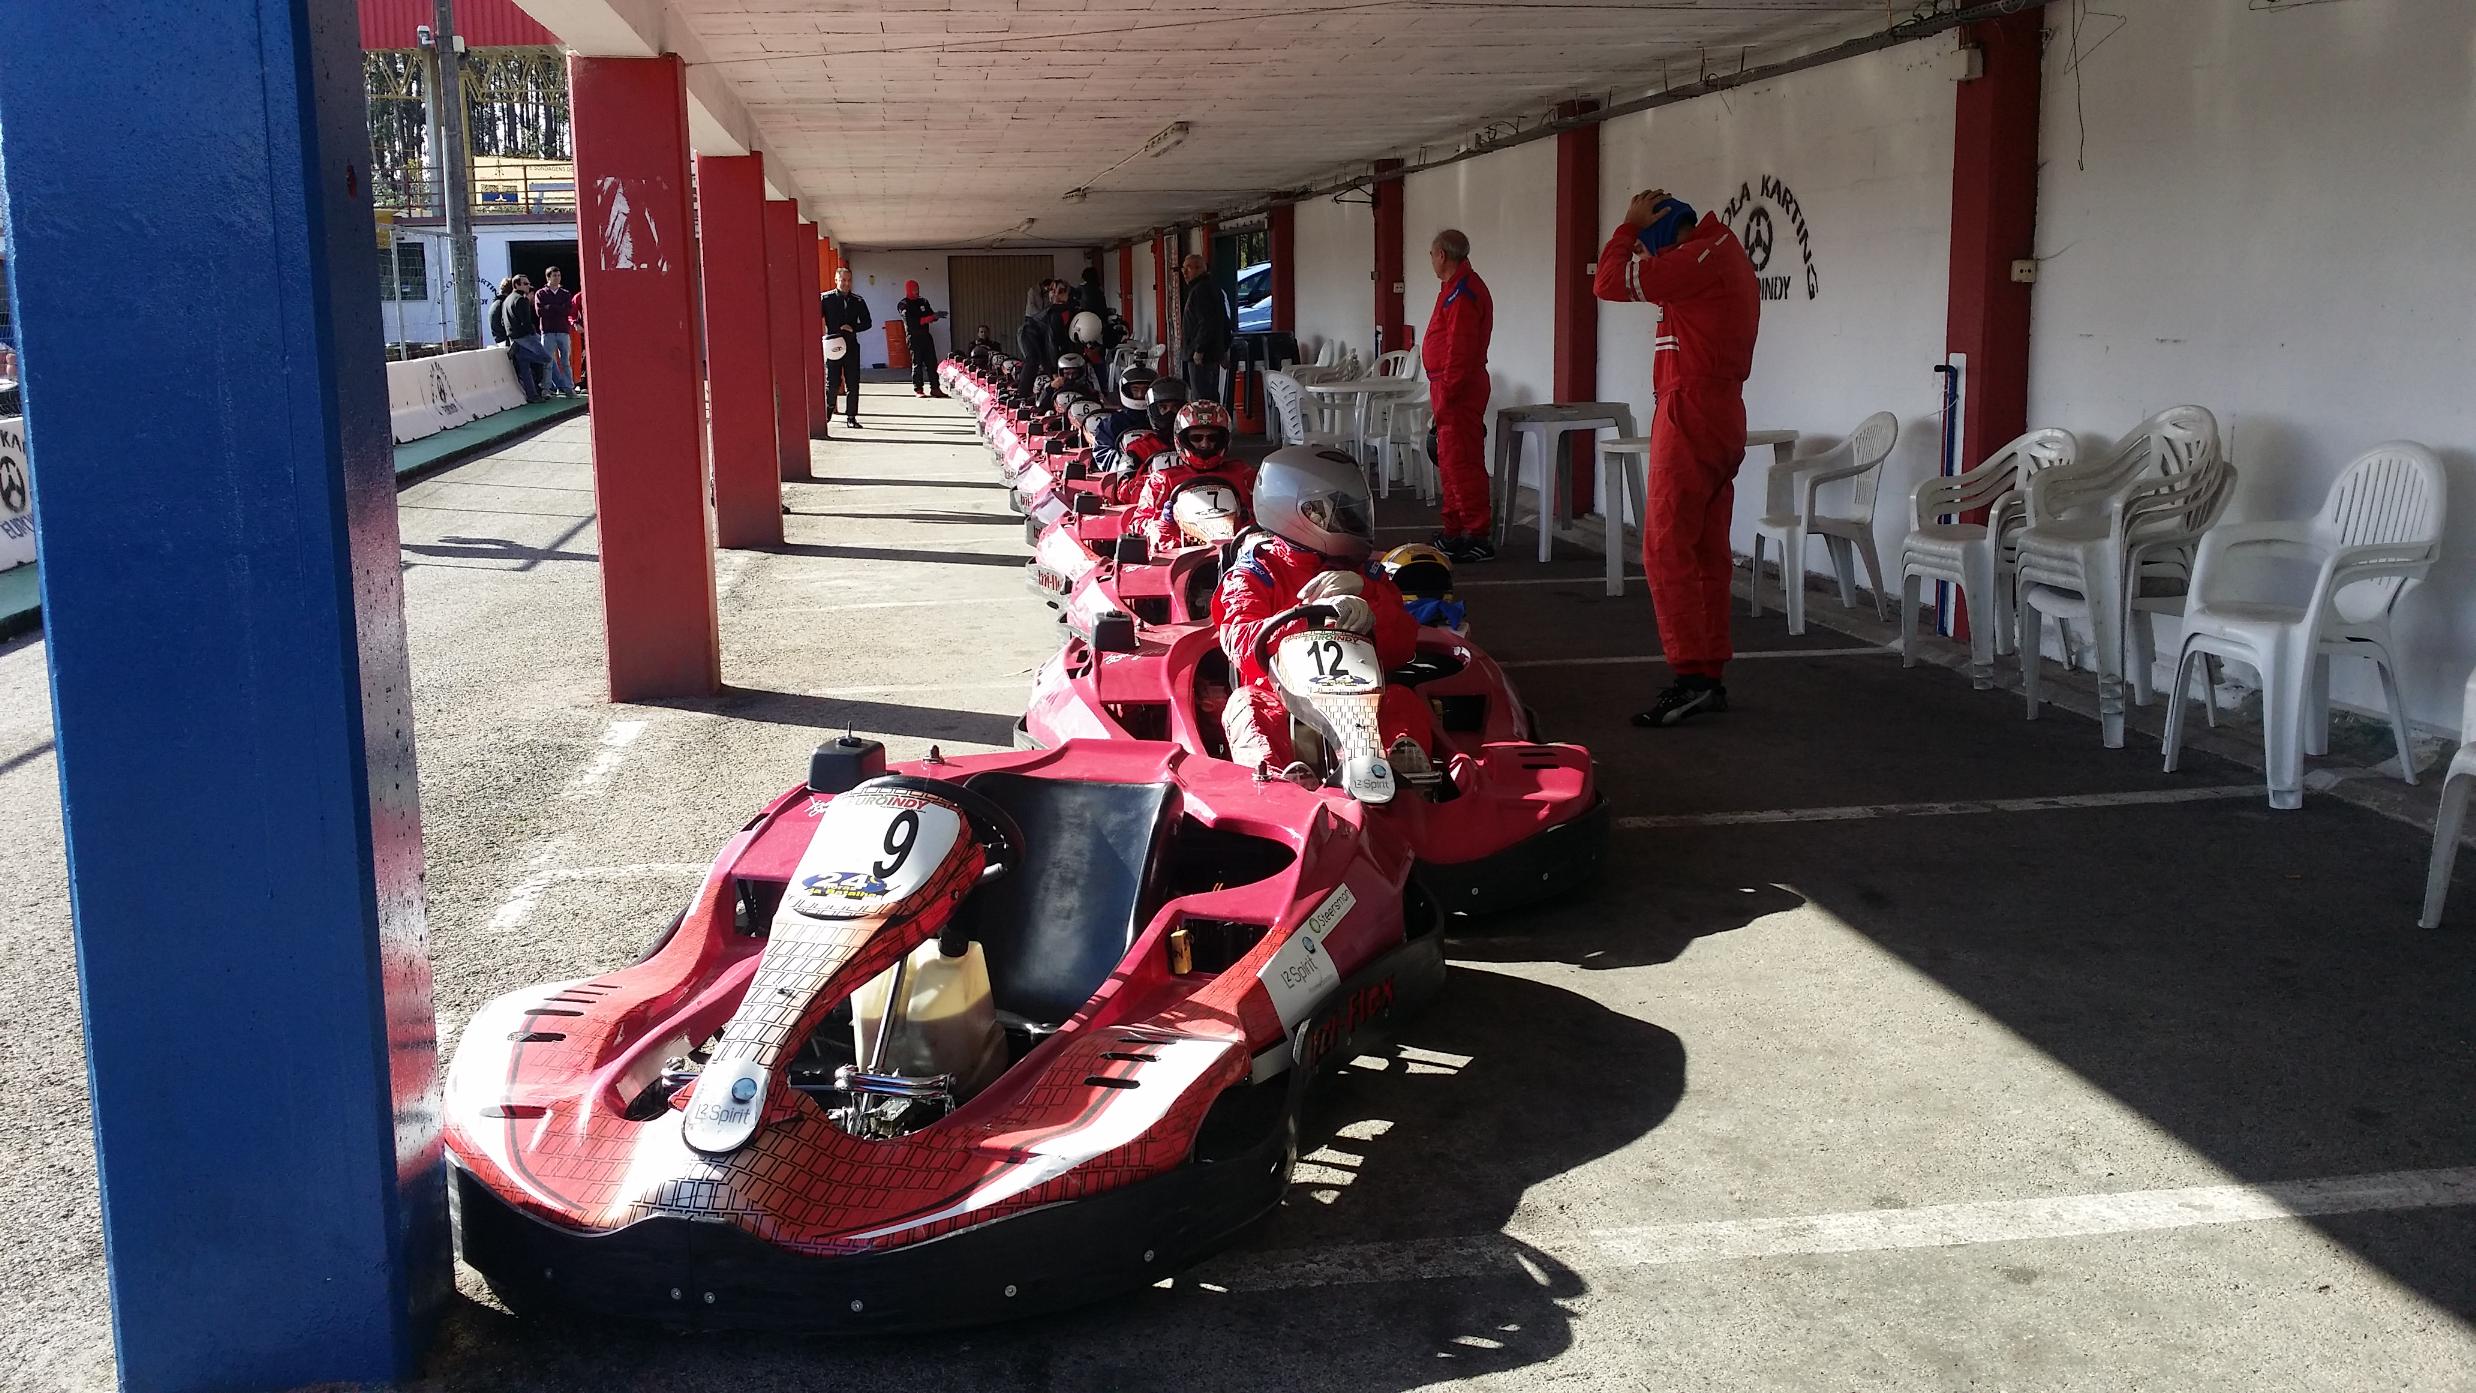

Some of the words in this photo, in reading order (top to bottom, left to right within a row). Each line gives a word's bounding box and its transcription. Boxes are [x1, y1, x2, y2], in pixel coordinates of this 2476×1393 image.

[1760, 174, 1818, 301] KARTING
[1083, 404, 1090, 414] 6
[1207, 491, 1219, 509] 7
[1307, 641, 1349, 676] 12
[872, 809, 920, 879] 9
